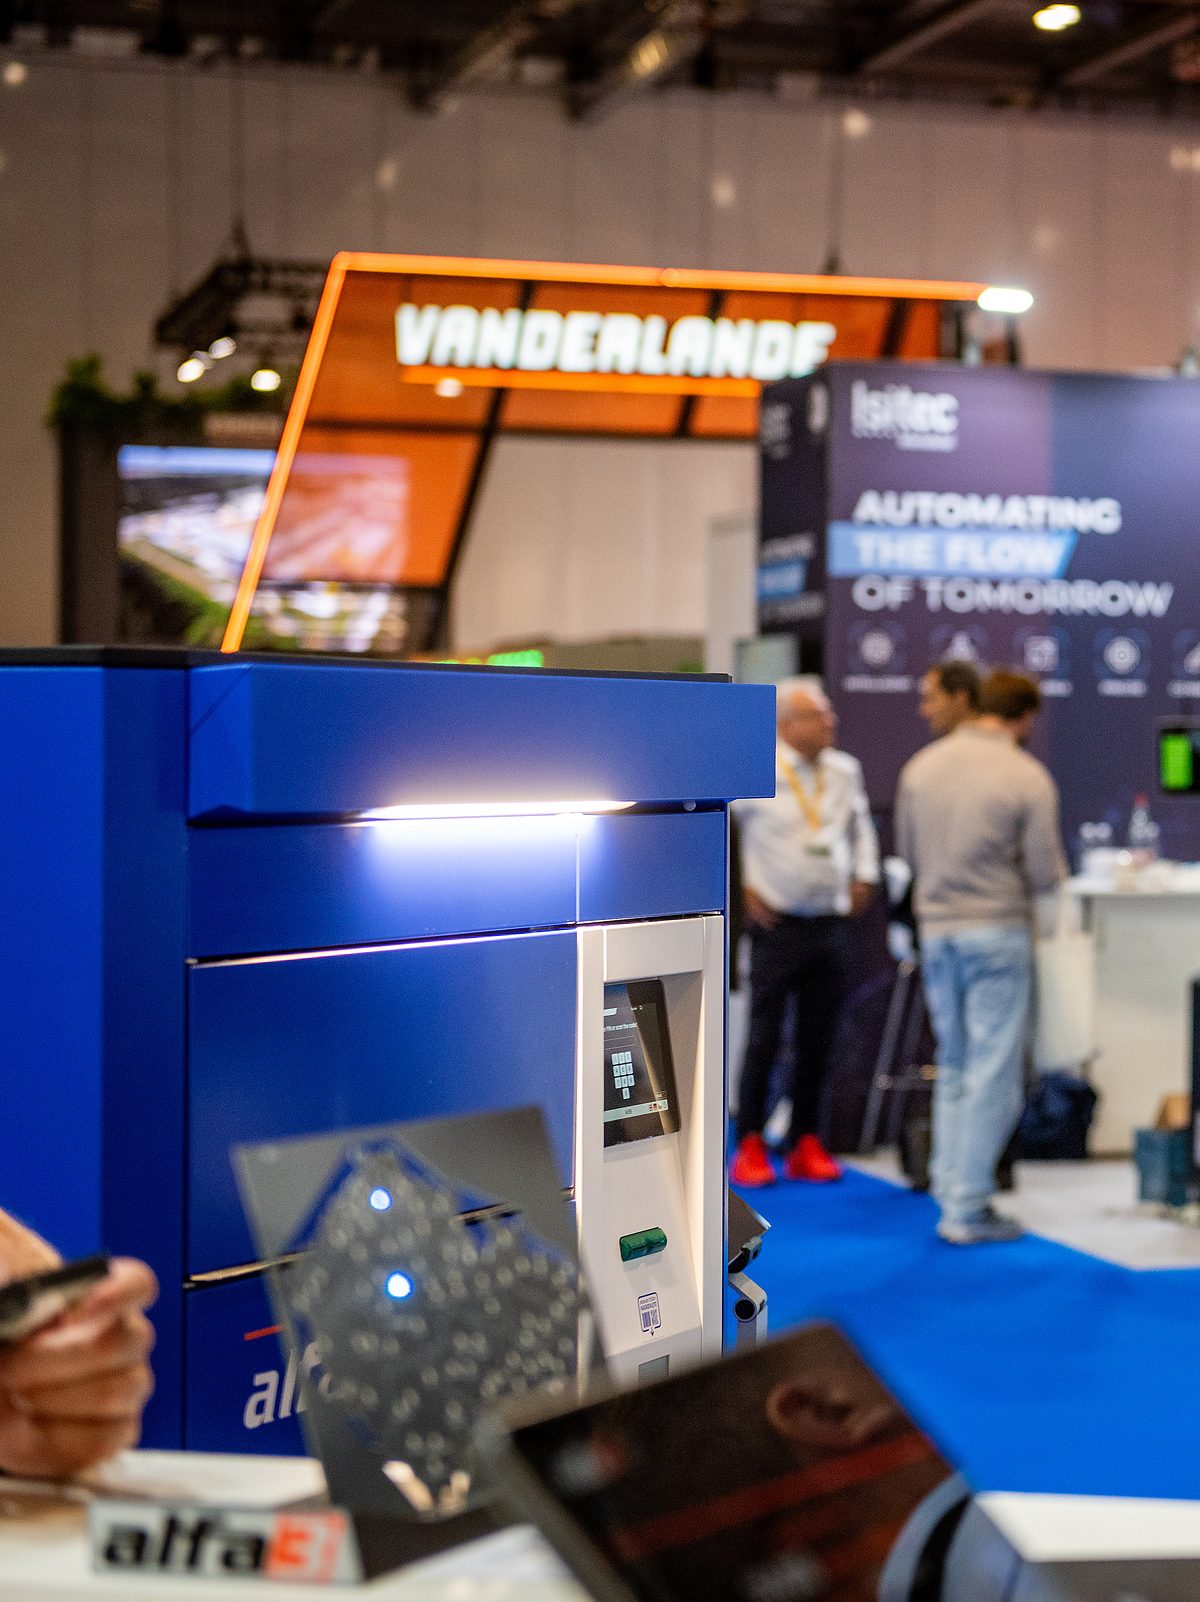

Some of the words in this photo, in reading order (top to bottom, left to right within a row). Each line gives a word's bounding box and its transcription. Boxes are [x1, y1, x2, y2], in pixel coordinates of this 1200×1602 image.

[395, 303, 836, 381] VANDERLANDE
[852, 489, 1121, 534] AUTOMATING
[856, 531, 936, 570] THE
[944, 534, 1066, 574] FLOW
[852, 572, 916, 611] OF
[919, 576, 1174, 617] TOMORROW
